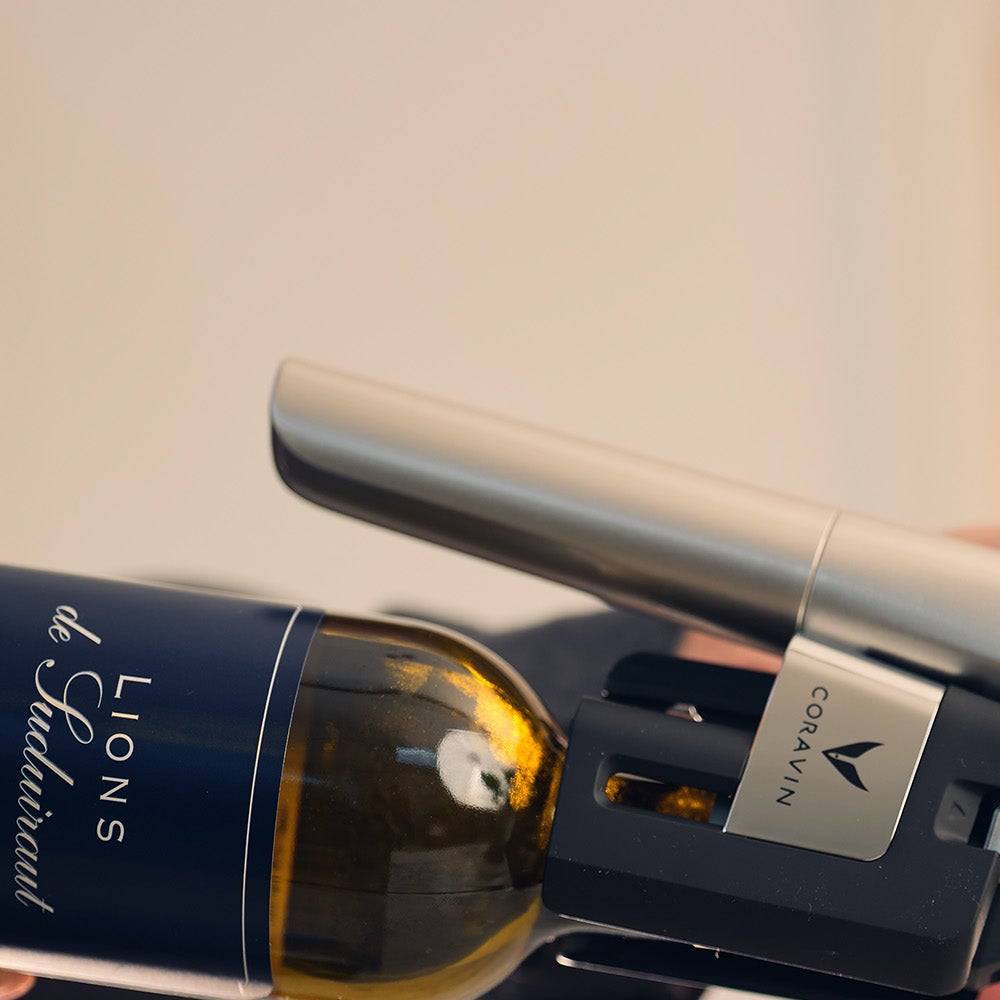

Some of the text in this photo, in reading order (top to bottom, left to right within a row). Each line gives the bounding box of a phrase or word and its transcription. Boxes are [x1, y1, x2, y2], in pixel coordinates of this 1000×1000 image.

[14, 605, 103, 914] de Suduiraut
[96, 675, 152, 843] LIONS
[777, 687, 828, 806] CORAVIN
